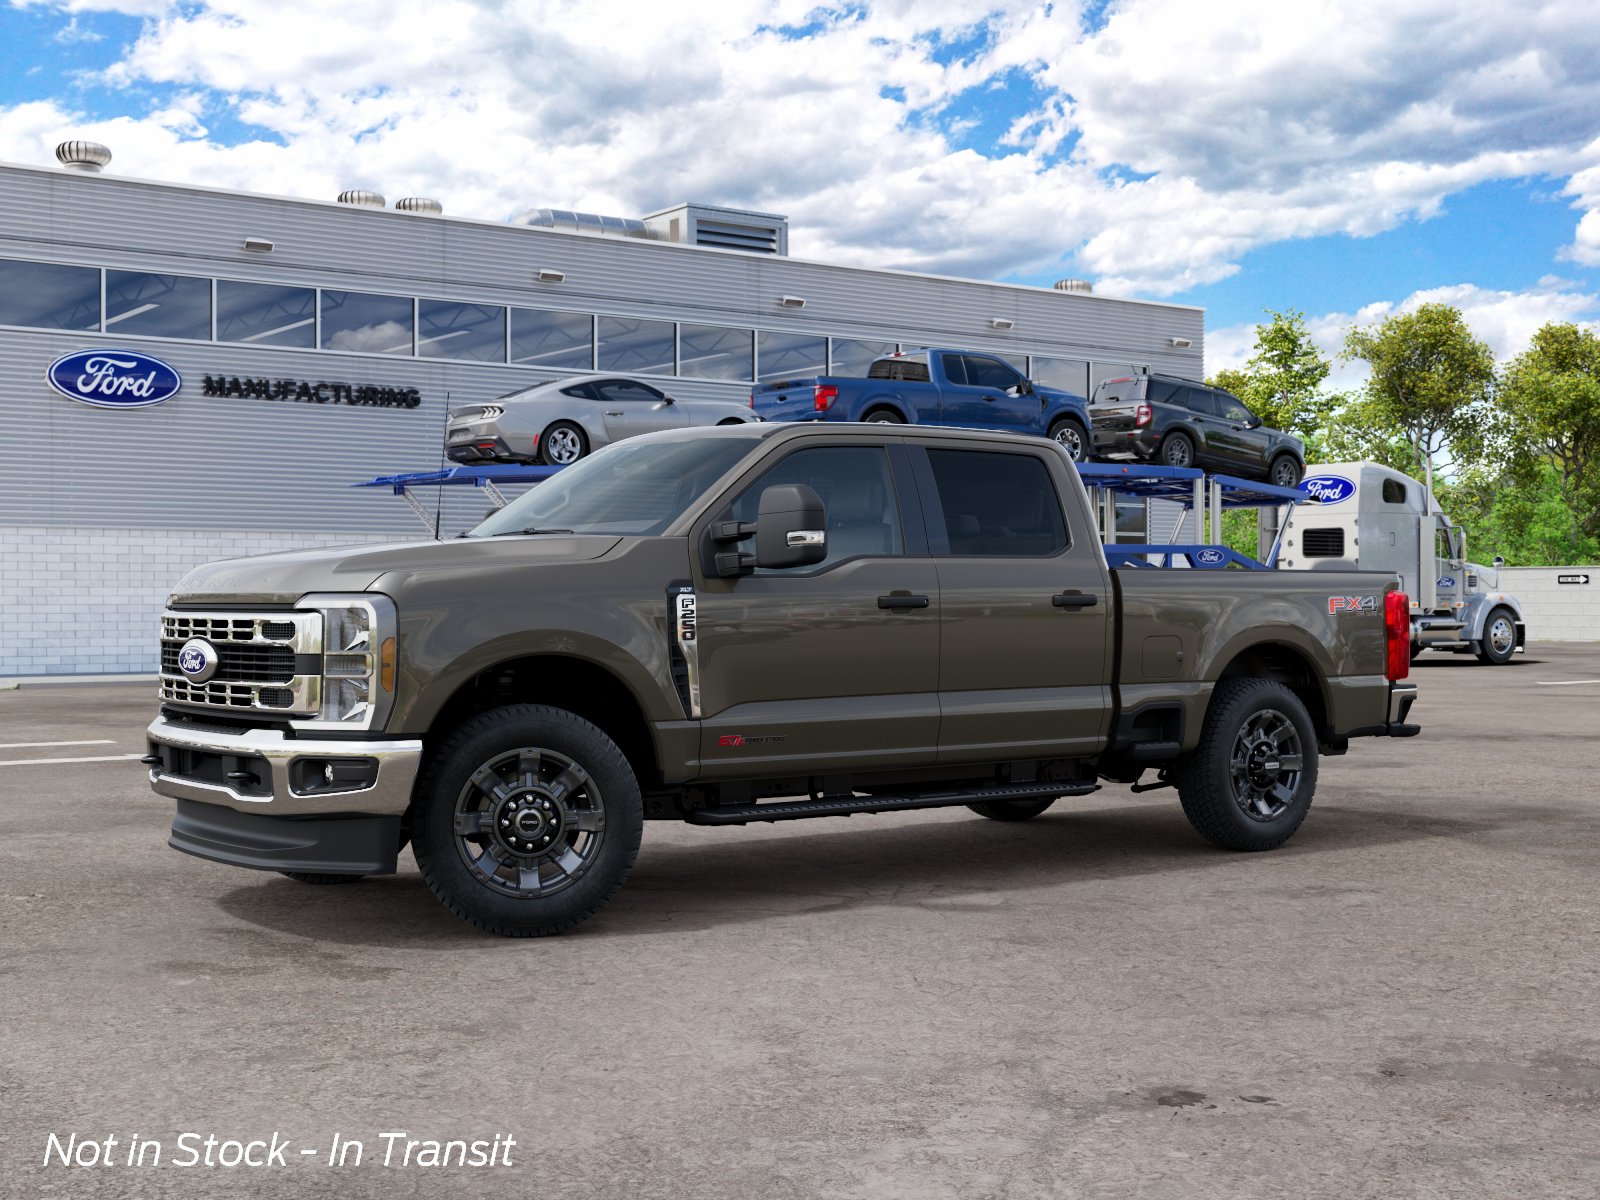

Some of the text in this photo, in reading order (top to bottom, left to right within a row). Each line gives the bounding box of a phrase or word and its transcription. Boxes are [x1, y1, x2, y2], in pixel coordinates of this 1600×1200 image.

[77, 357, 421, 408] Ford MANUFACTURING
[1305, 480, 1343, 500] Ford
[1328, 596, 1377, 616] FX4
[183, 650, 202, 670] Ford
